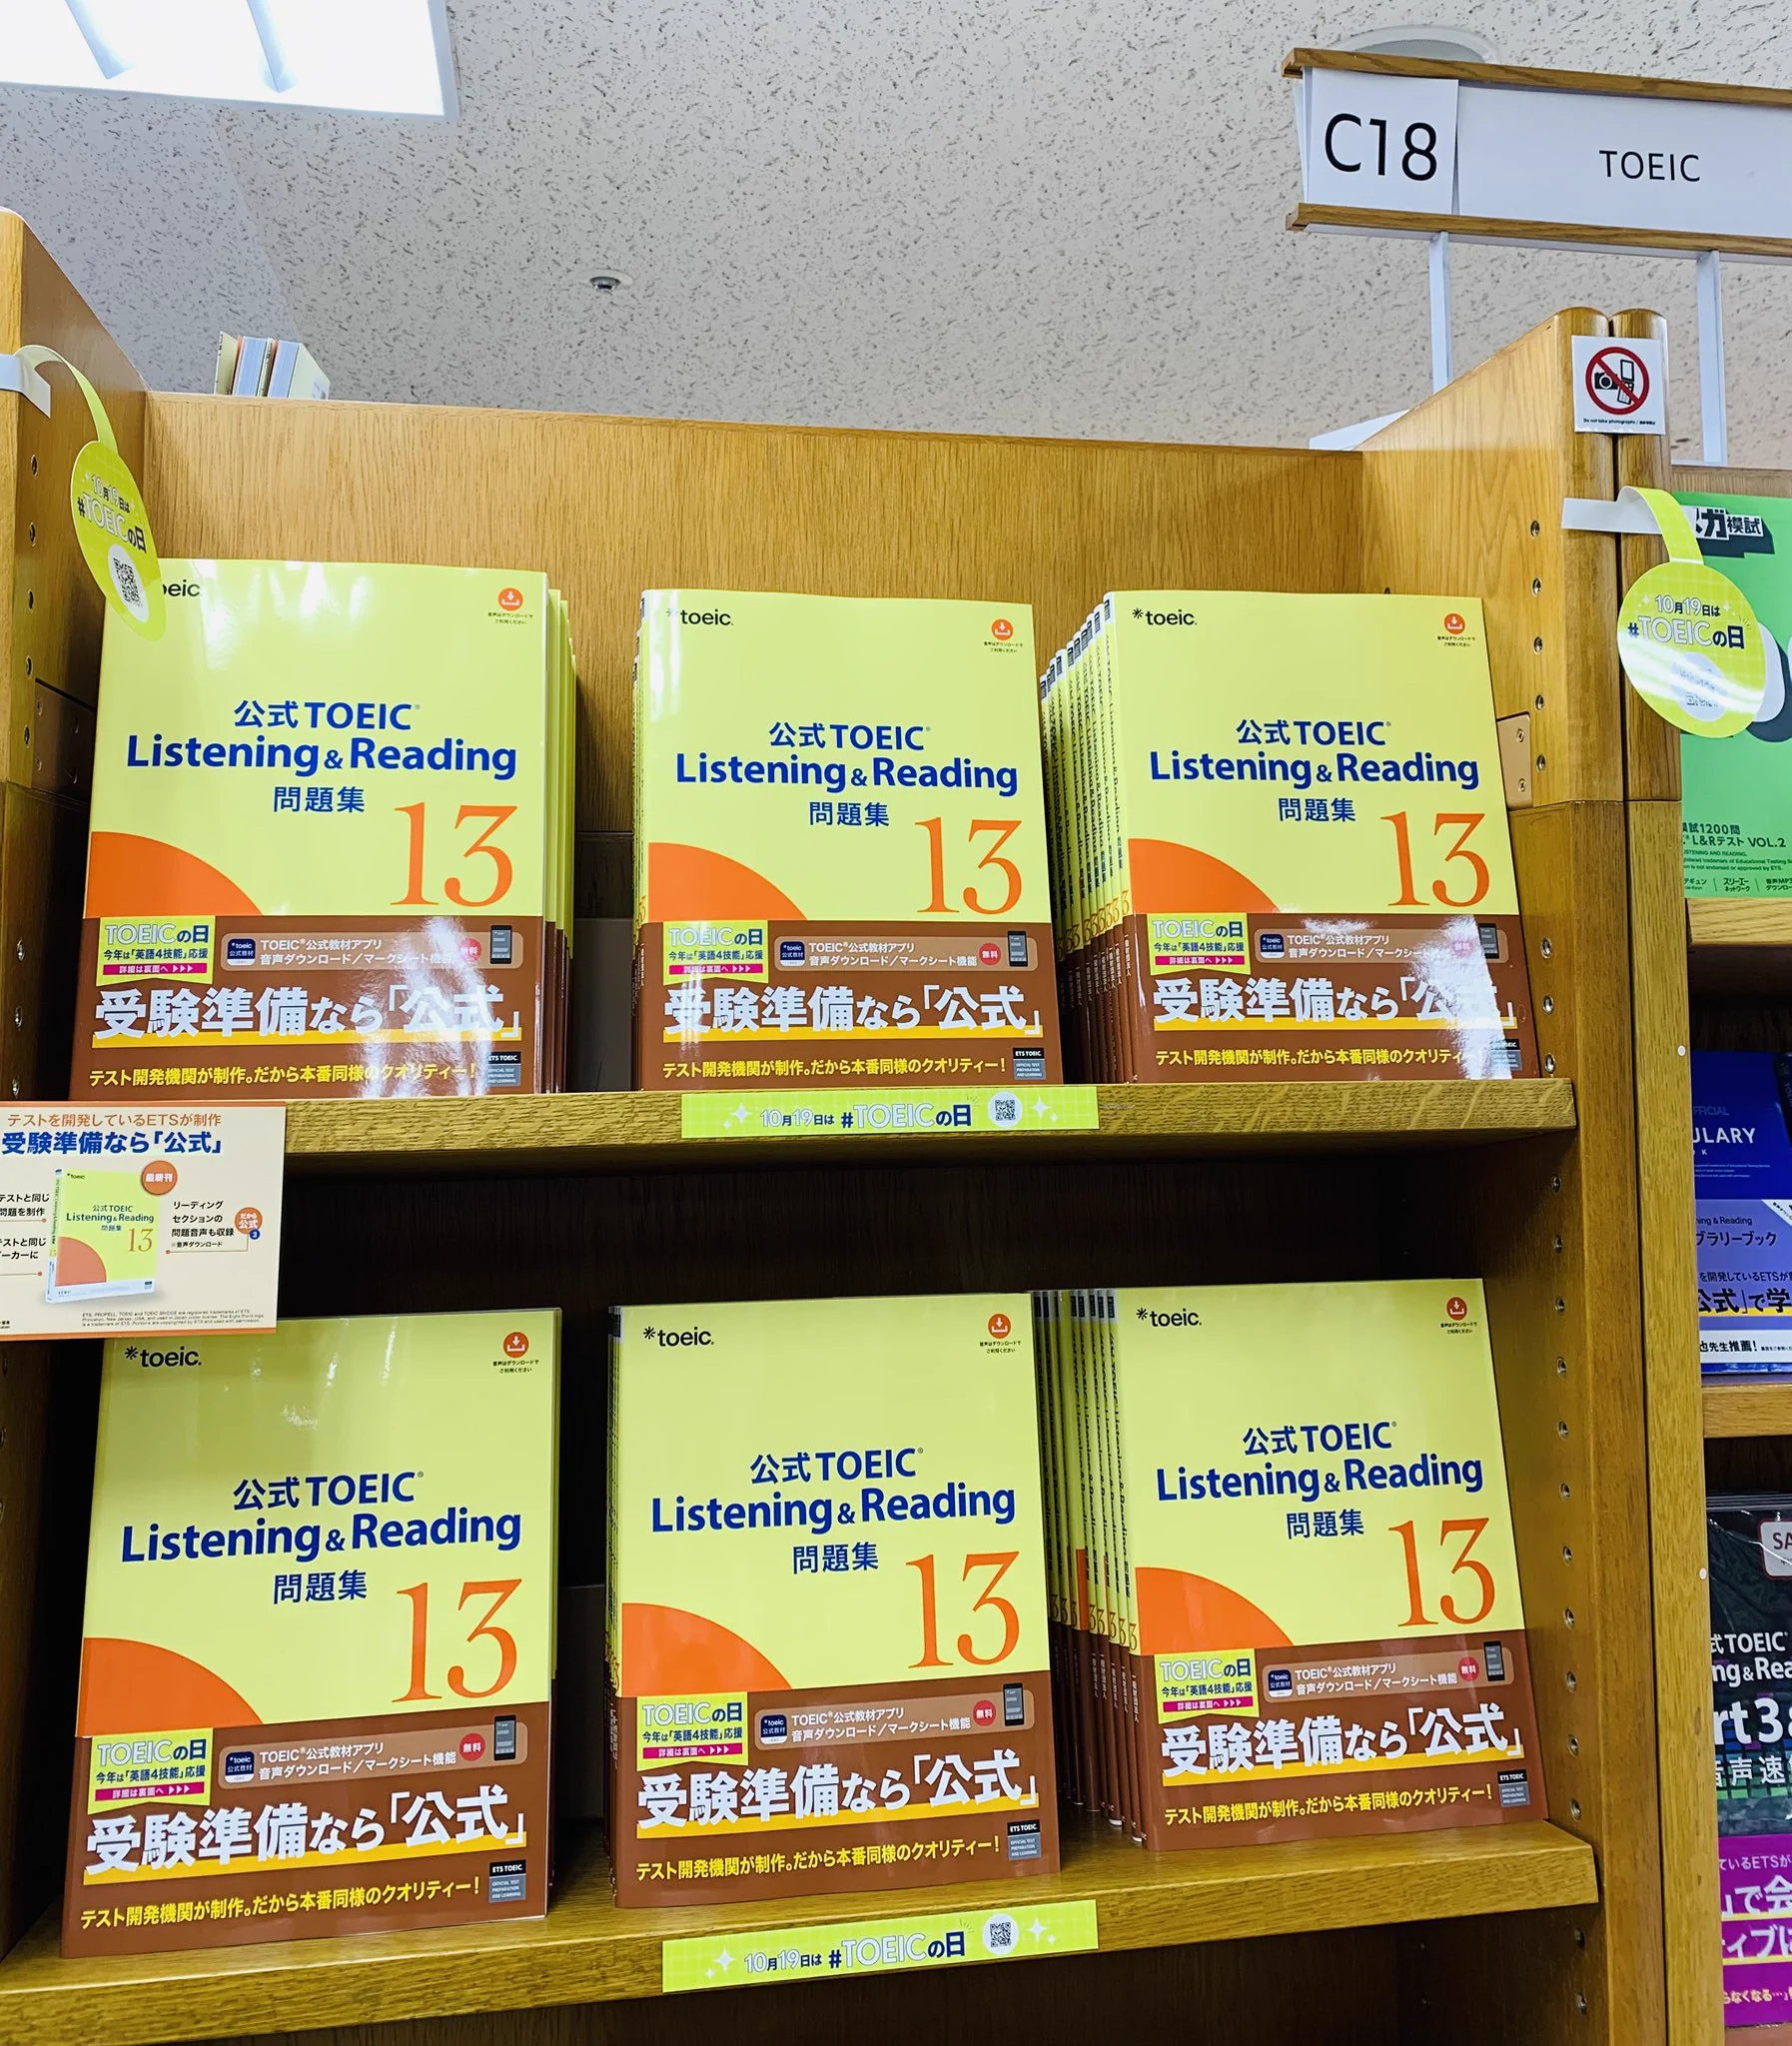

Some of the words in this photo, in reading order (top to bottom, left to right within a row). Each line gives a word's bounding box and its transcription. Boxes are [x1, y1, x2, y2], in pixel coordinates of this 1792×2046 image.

[1324, 113, 1438, 182] C18
[1598, 149, 1701, 183] TOEIC
[1655, 594, 1720, 616] 10月19日は
[1628, 615, 1745, 649] #TOEICの日
[127, 733, 319, 777] Listening
[324, 749, 343, 769] &
[350, 736, 516, 780] Reading
[1150, 749, 1312, 789] Listening
[1316, 764, 1332, 783] &
[1337, 751, 1479, 790] Reading
[676, 752, 845, 793] Listening
[851, 767, 867, 786] &
[873, 757, 1018, 796] Reading
[273, 785, 365, 813] 問題集
[1279, 797, 1355, 822] 問題集
[809, 801, 890, 827] 問題集
[390, 802, 517, 907] 13
[1748, 837, 1786, 847] VOL.2
[914, 817, 1023, 915] 13
[1380, 810, 1490, 908] 13
[105, 923, 209, 945] TOEICの日
[668, 927, 763, 947] TOEICの日
[1153, 920, 1244, 939] TOEICの日
[809, 953, 978, 967] 音声ダウンロード／マークシート機能
[95, 984, 519, 1038] 受験準備なら「公式」
[664, 984, 1040, 1036] 受験準備なら「公式」
[662, 1057, 1006, 1079] テスト開発機関が制作。だから本番同様のクオリティー！
[8, 1114, 222, 1127] テストを開発しているETSが制作
[2, 1131, 222, 1155] 受験準備なら「公式」
[145, 1173, 174, 1183] 最新刊
[66, 1213, 113, 1223] Listening
[119, 1214, 155, 1223] Reading
[173, 1215, 223, 1224] セクションの
[174, 1201, 224, 1210] リーディング
[172, 1228, 234, 1237] 問題音声も収録
[1720, 1217, 1752, 1226] Reading
[128, 1229, 154, 1252] 13
[0, 1251, 38, 1260] ーカーに
[1156, 1462, 1320, 1503] Listening
[1324, 1474, 1341, 1493] &
[1344, 1453, 1482, 1492] Reading
[652, 1492, 832, 1534] Listening
[837, 1504, 855, 1525] &
[861, 1483, 1016, 1525] Reading
[122, 1517, 321, 1562] Listening
[325, 1529, 346, 1551] &
[352, 1507, 521, 1550] Reading
[1286, 1508, 1364, 1539] 問題集
[793, 1541, 879, 1575] 問題集
[1387, 1517, 1496, 1627] 13
[274, 1568, 368, 1604] 問題集
[905, 1550, 1020, 1668] 13
[392, 1577, 522, 1703] 13
[1160, 1657, 1252, 1682] TOEICの日
[1296, 1671, 1458, 1696] 音声ダウンロード／マークシート機能
[1743, 1666, 1754, 1681] &
[642, 1701, 742, 1726] TOEICの日
[1754, 1697, 1784, 1743] 3
[642, 1727, 742, 1743] 今年は「英語4技能」応援
[791, 1715, 971, 1742] 音声ダウンロード／マークシート機能
[1161, 1702, 1521, 1777] 受験準備なら「公式」
[97, 1738, 207, 1767] TOEICの日
[462, 1741, 481, 1753] 無料
[96, 1764, 206, 1784] 今年は「英語4技能」応援
[259, 1751, 456, 1781] 音声ダウンロード／マークシート機能
[636, 1748, 1036, 1829] 受験準備なら「公式」
[1164, 1783, 1492, 1826] テスト開発機関が制作。だから本番同様のクオリティー！
[86, 1783, 524, 1875] 受験準備なら「公式」
[635, 1835, 999, 1881] テスト開発機関が制作。だから本番同様のクオリティー！
[80, 1875, 479, 1930] テスト開発機関が制作。だから本番同様のクオリティー！
